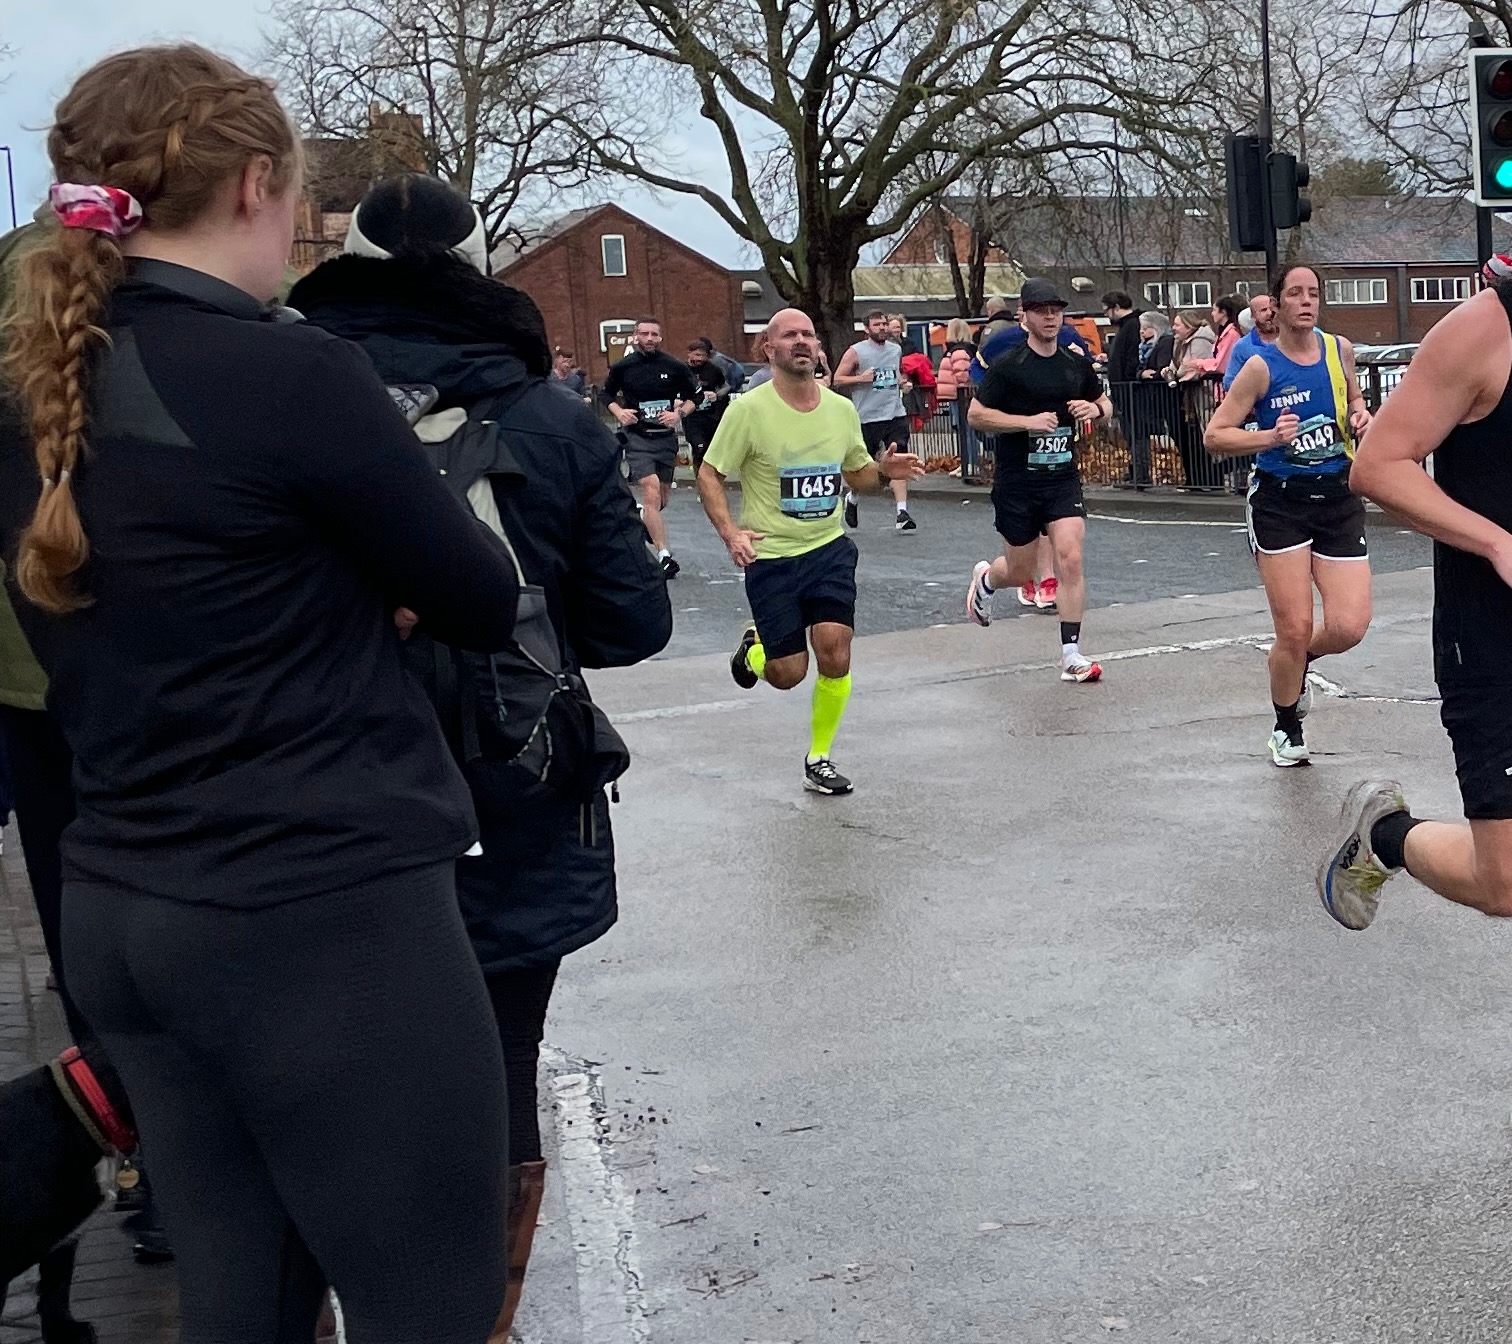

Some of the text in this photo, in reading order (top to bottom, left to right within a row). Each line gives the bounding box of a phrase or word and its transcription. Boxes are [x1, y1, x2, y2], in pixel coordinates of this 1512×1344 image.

[610, 336, 626, 345] Car
[1270, 390, 1312, 409] JENNY
[1036, 436, 1068, 453] 2502
[1290, 424, 1334, 455] 3049
[792, 475, 835, 498] 1645
